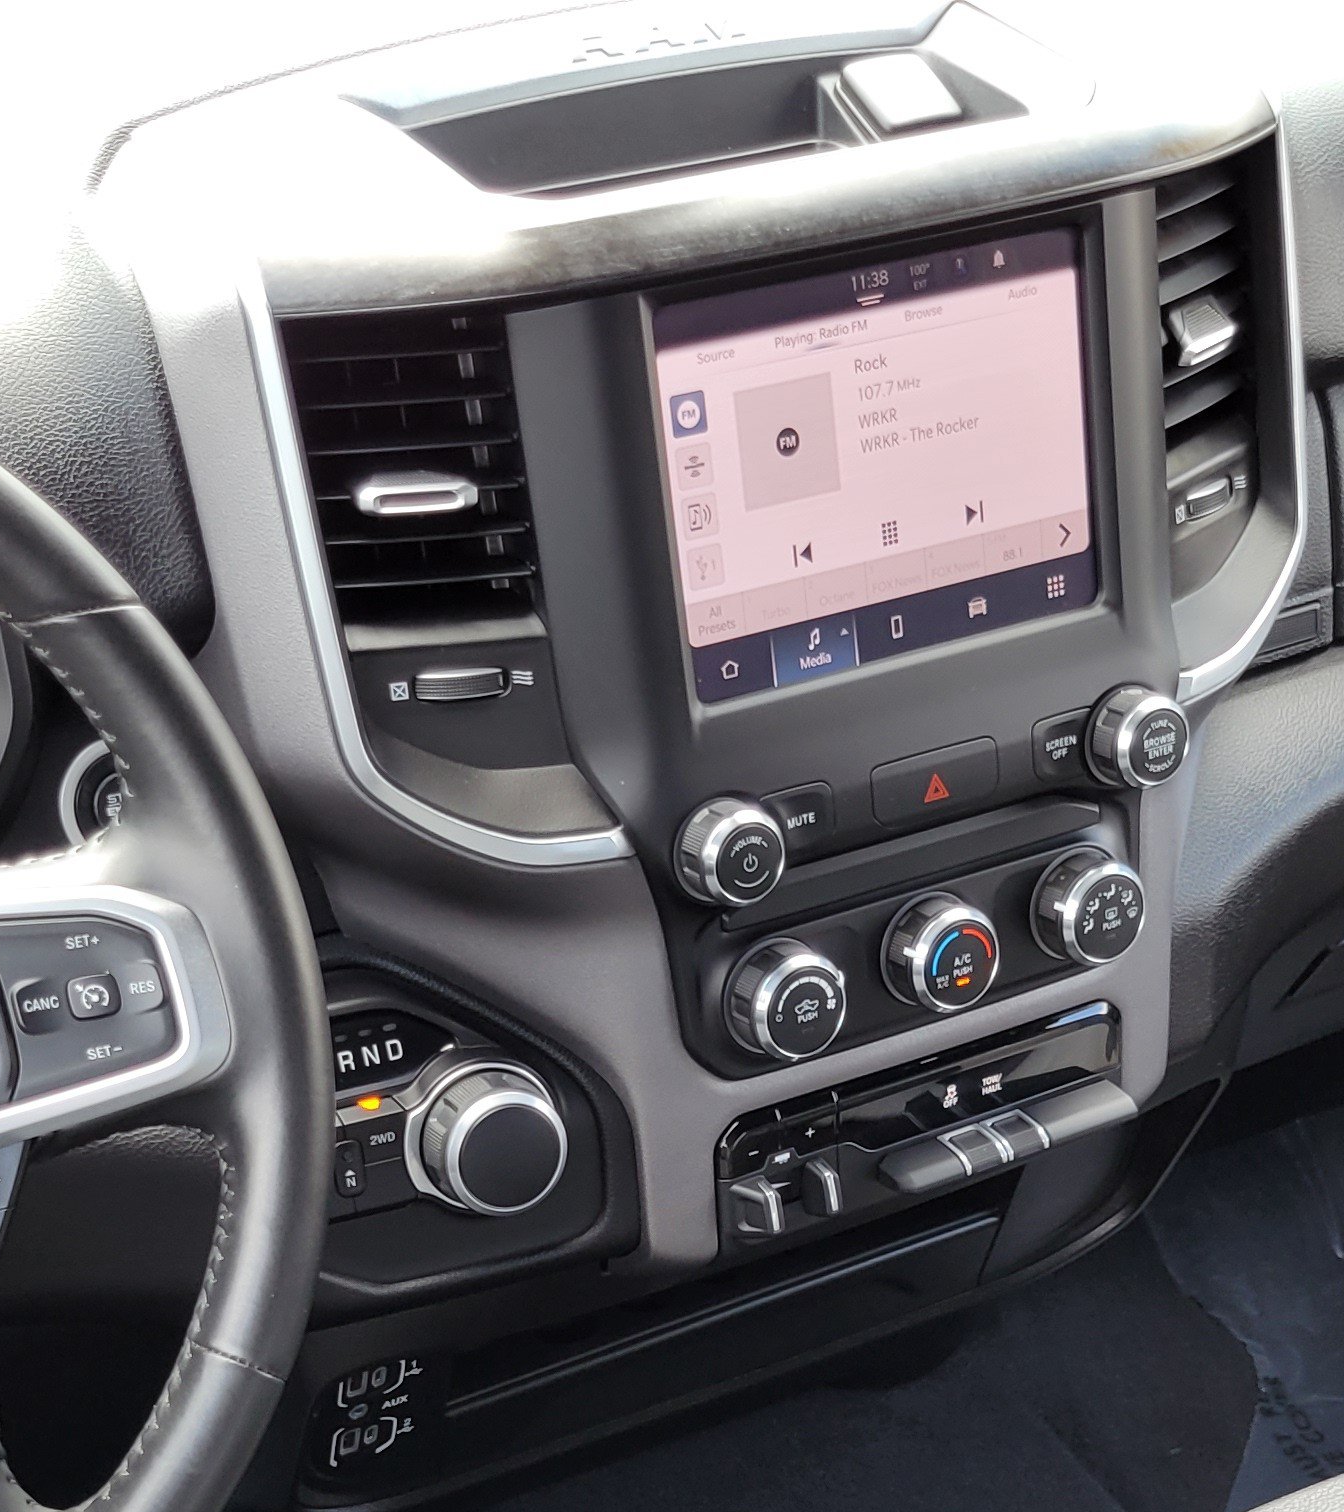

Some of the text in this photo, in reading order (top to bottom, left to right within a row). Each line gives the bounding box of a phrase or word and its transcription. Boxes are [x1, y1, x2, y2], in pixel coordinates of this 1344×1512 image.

[851, 270, 889, 291] 11:38
[1008, 284, 1037, 300] Audio
[904, 304, 942, 322] Browse
[819, 322, 849, 340] Radio
[851, 319, 868, 333] FM
[696, 347, 735, 365] Source
[854, 354, 888, 374] Rock
[857, 377, 921, 402] 107.7 MHz
[681, 407, 696, 421] FM
[858, 408, 898, 428] WRKR
[780, 434, 796, 450] FM
[860, 432, 900, 454] WRKR
[910, 423, 934, 443] The
[936, 415, 980, 439] Rocker
[708, 605, 723, 619] All
[697, 618, 736, 638] Presets
[799, 653, 832, 671] Media
[1150, 719, 1168, 730] TUNE
[1046, 735, 1076, 752] SCREEN
[1143, 732, 1175, 747] BROWSE
[1052, 747, 1068, 760] OFF
[1148, 745, 1173, 760] ENTER
[1149, 760, 1173, 773] SCROLL
[787, 812, 815, 830] MUTE
[733, 836, 762, 851] VOLUME
[1102, 918, 1122, 931] PUSH
[954, 953, 971, 967] A/C
[953, 965, 973, 978] PUSH
[130, 980, 155, 996] RES
[23, 996, 60, 1014] CANC
[797, 1010, 819, 1024] PUSH
[337, 1039, 403, 1073] R N D
[982, 1083, 1002, 1096] HAUL
[943, 1096, 958, 1109] OFF
[370, 1132, 395, 1145] 2WD
[346, 1177, 357, 1188] N
[381, 1394, 409, 1410] AUX
